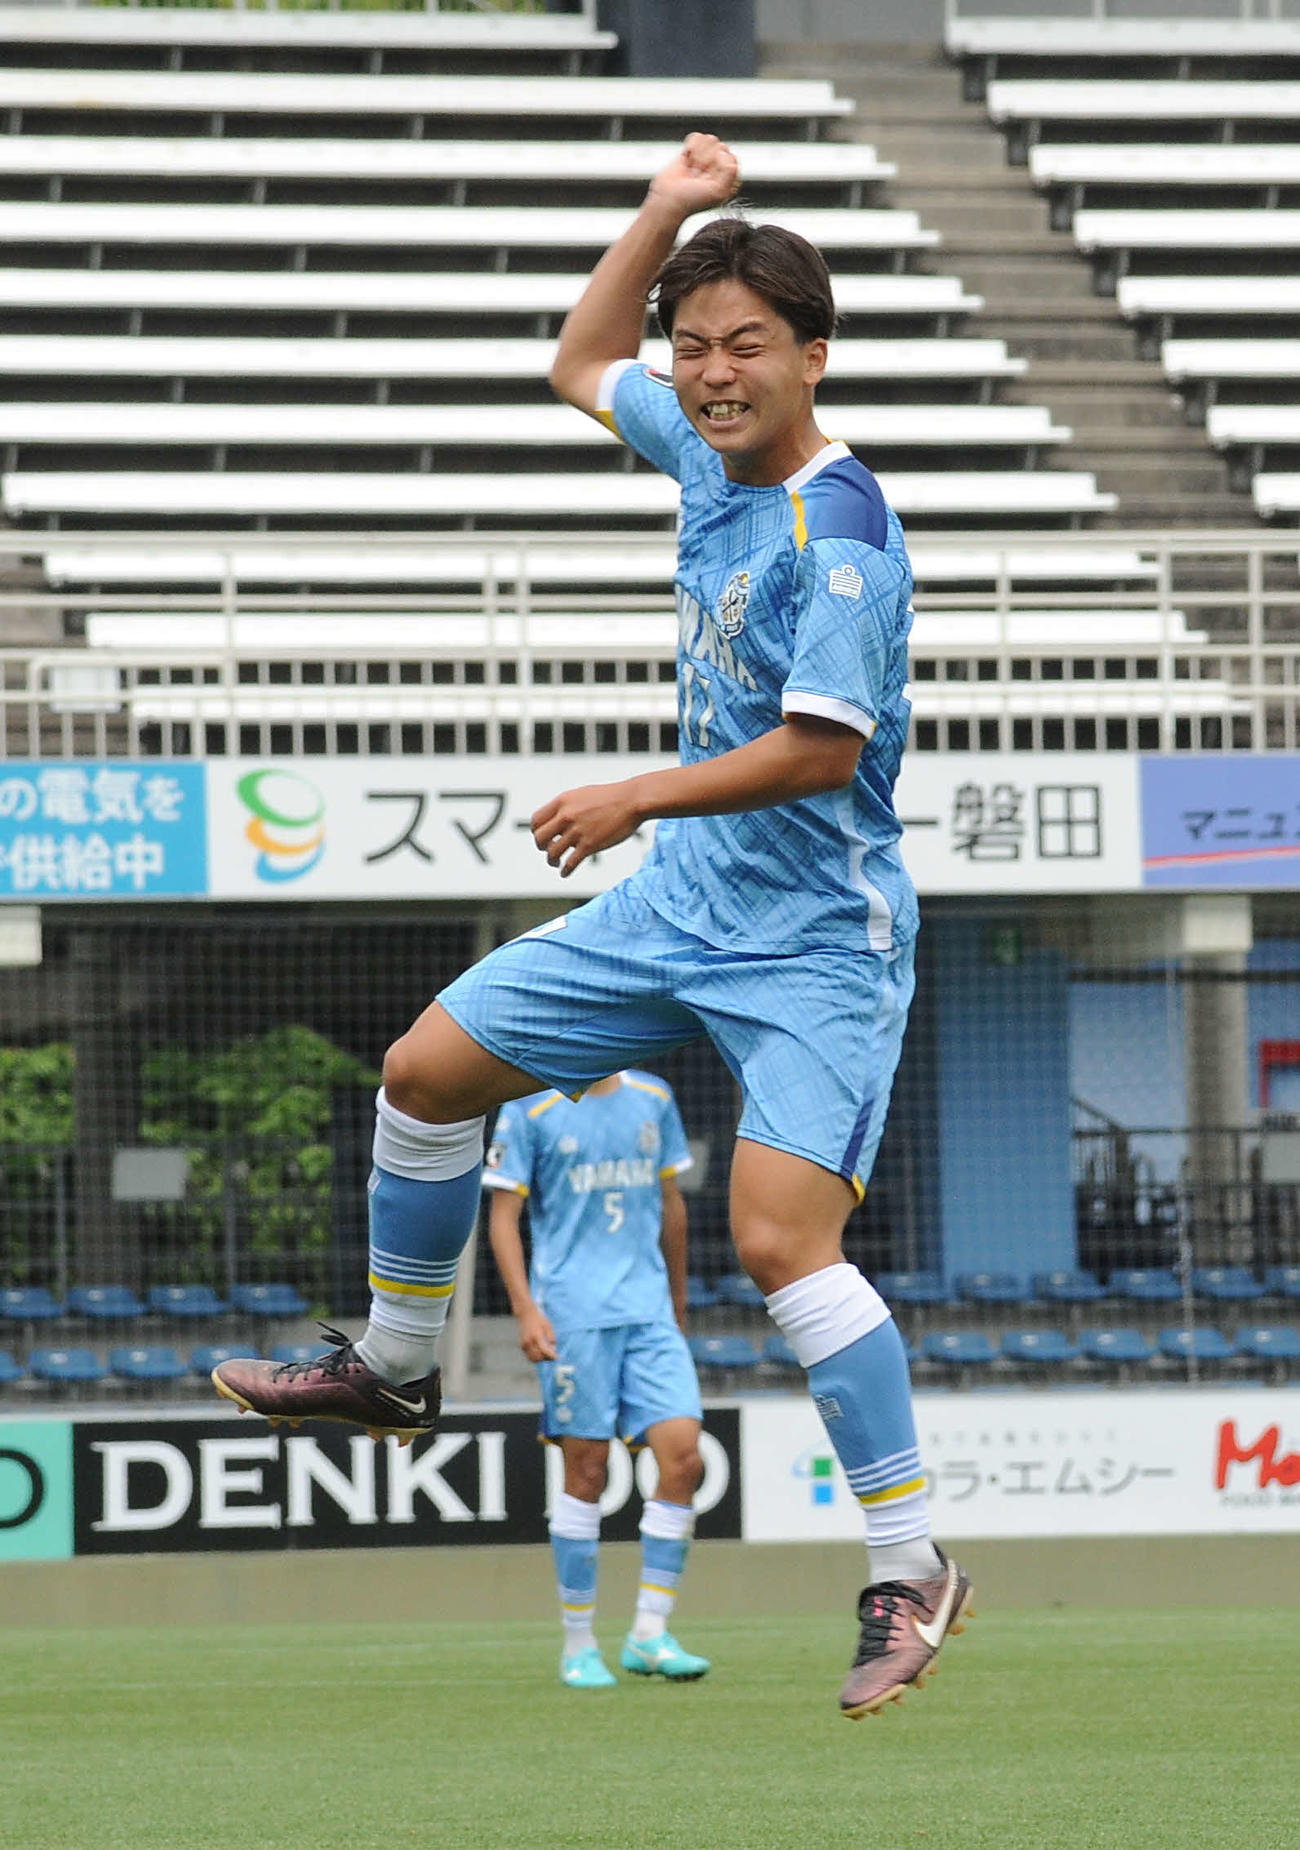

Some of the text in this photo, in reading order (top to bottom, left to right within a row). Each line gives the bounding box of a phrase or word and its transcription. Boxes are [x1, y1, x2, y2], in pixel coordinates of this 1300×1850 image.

[1180, 807, 1300, 841] マニュ
[0, 832, 165, 890] 供給中
[603, 1191, 625, 1233] 5
[553, 1365, 576, 1405] 5
[92, 1431, 508, 1533] DENKI
